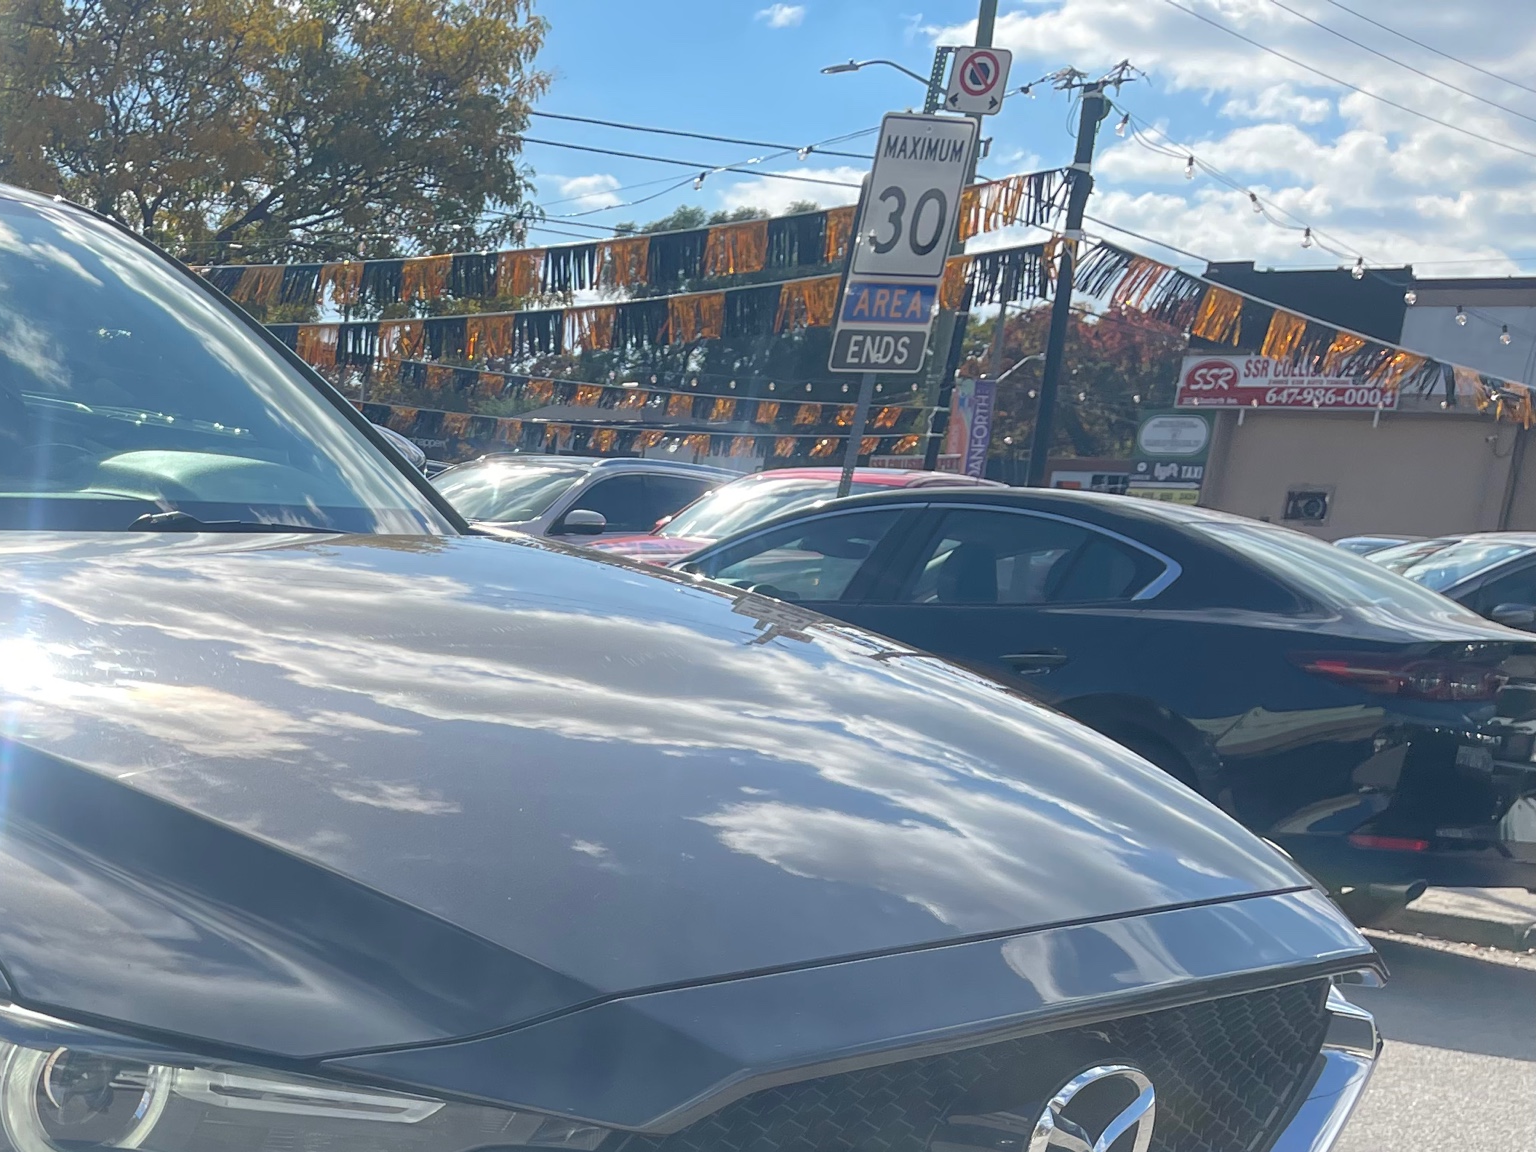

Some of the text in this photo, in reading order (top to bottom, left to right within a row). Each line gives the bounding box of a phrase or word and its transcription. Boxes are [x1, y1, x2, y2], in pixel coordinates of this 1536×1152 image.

[884, 134, 965, 164] MAXIMUM
[872, 185, 948, 256] 30
[853, 288, 922, 320] AREA
[845, 334, 911, 365] ENDS
[1189, 366, 1234, 392] SSR
[1243, 358, 1270, 378] SSR
[1181, 465, 1204, 480] TAXI
